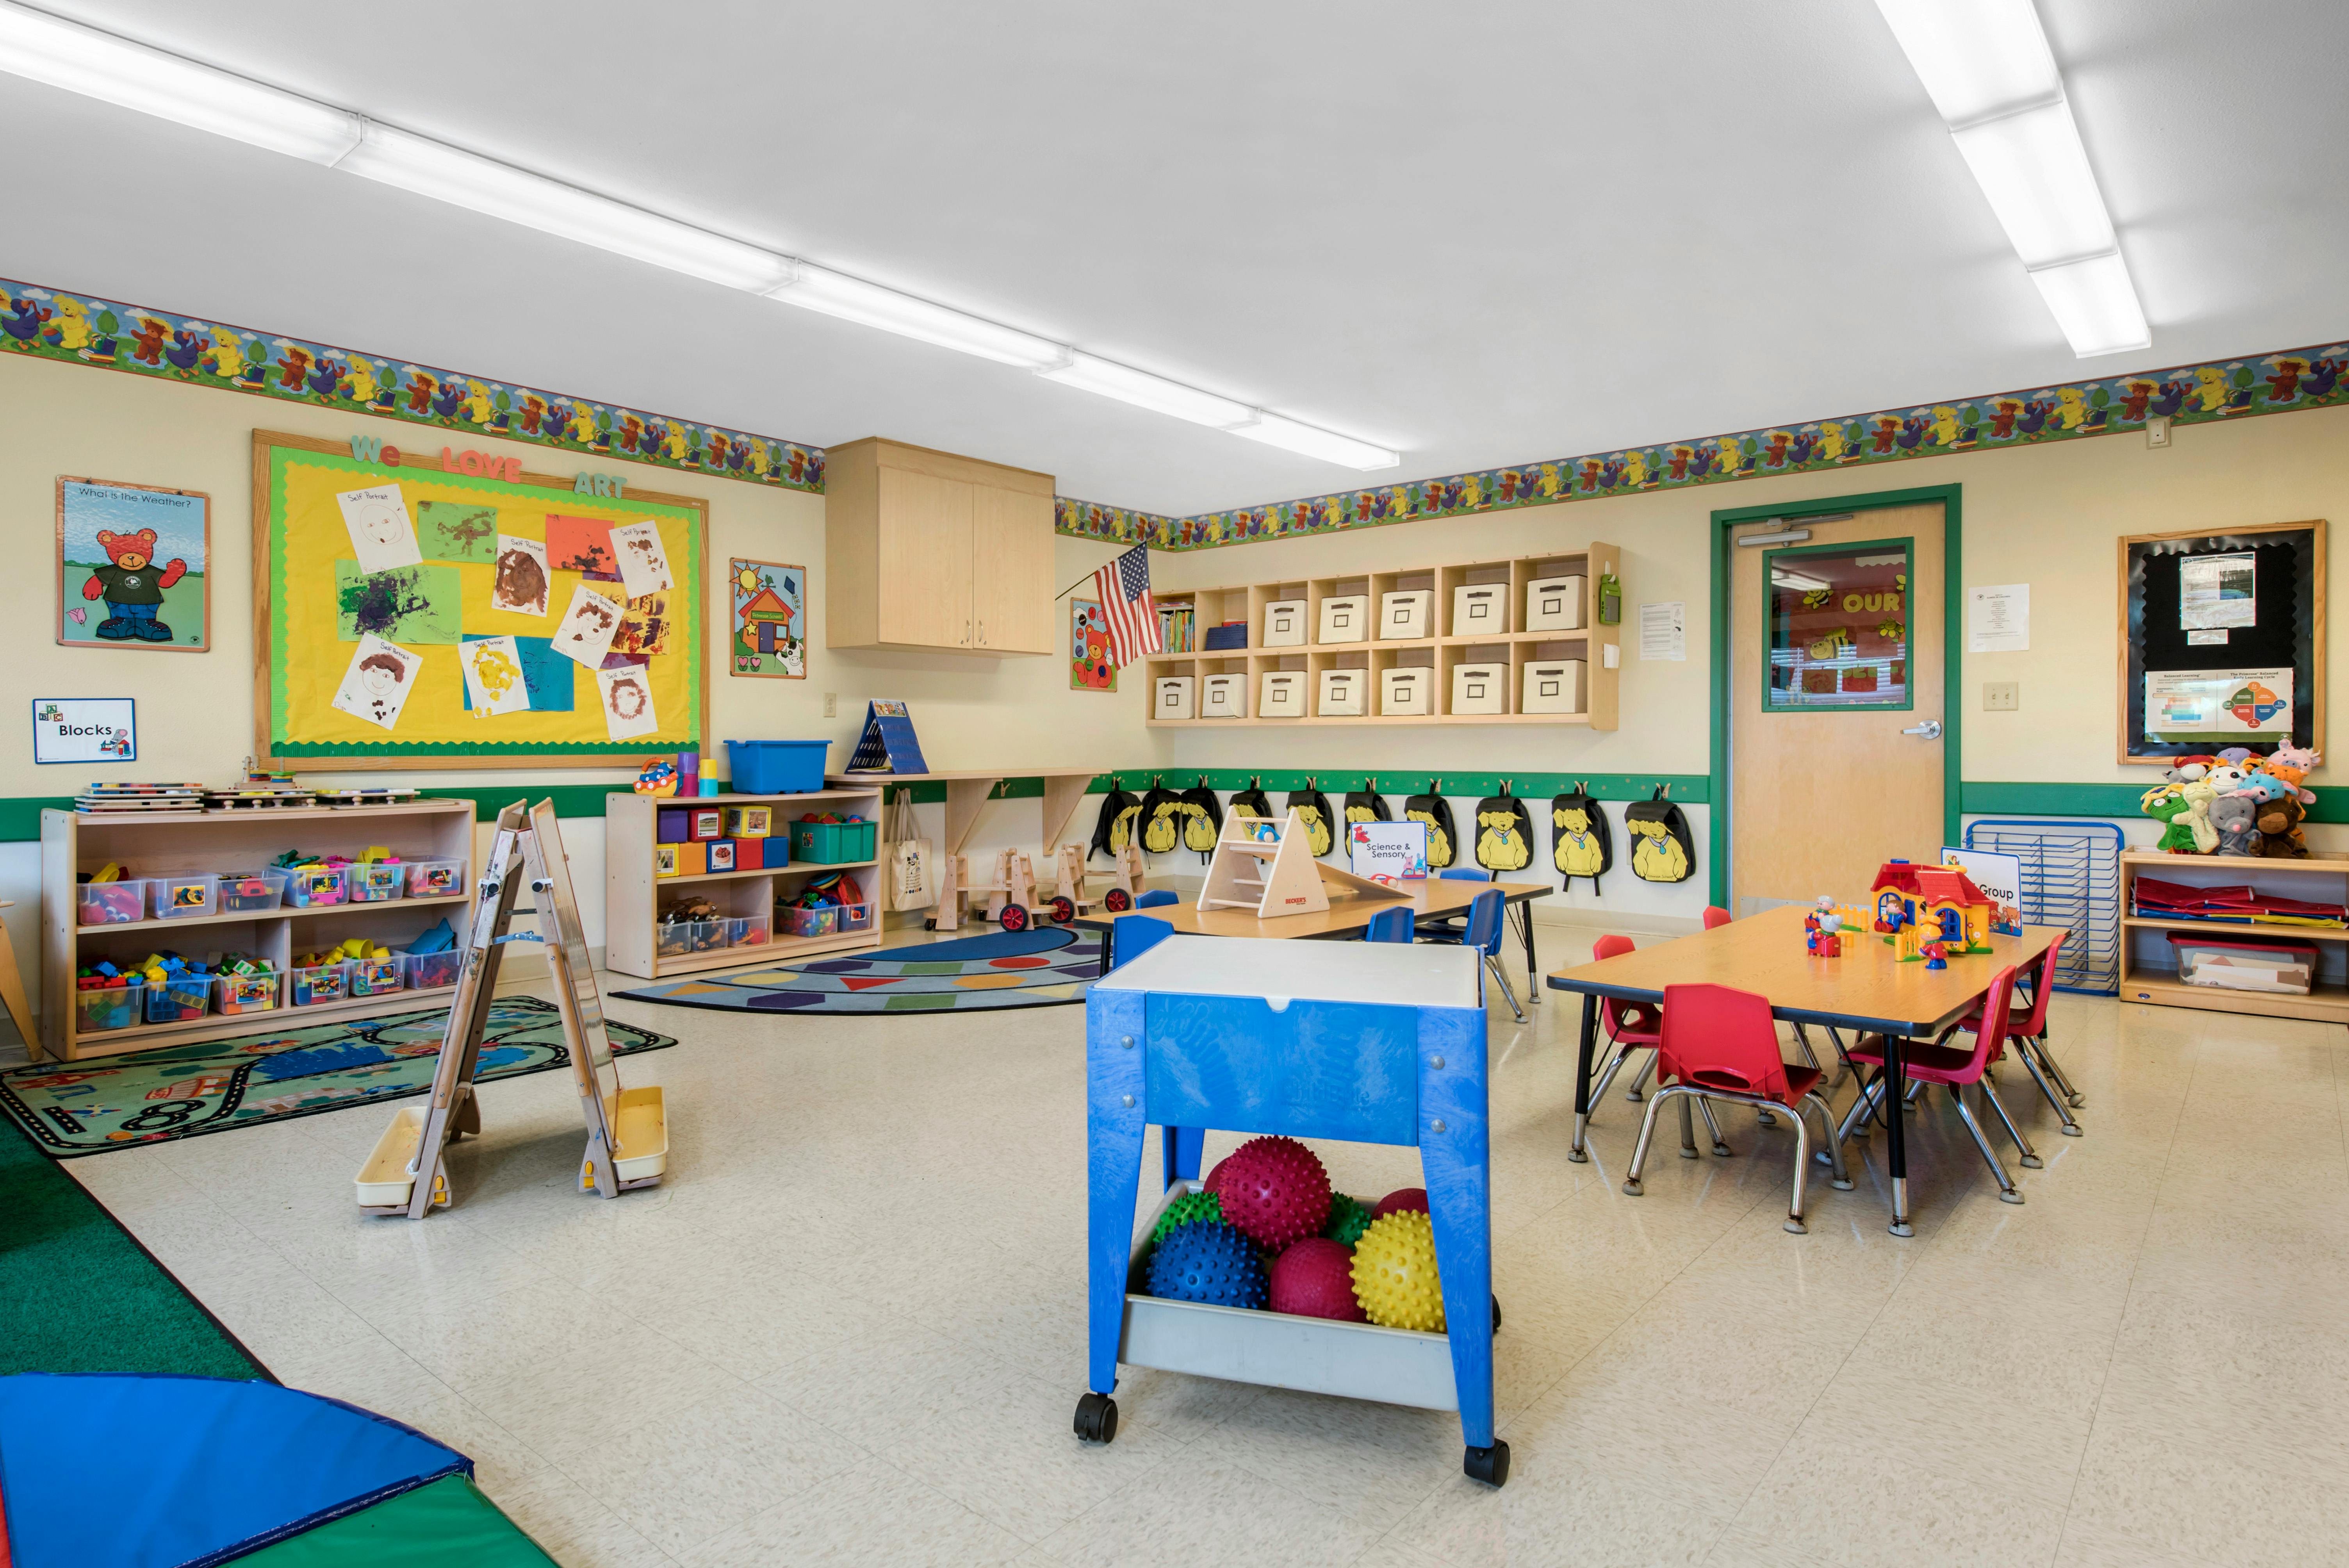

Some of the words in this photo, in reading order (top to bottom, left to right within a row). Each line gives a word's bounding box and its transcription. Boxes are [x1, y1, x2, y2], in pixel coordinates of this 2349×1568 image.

[351, 435, 400, 467] We
[442, 447, 522, 483] LOVE
[574, 471, 628, 499] ART
[79, 488, 107, 498] What
[121, 493, 138, 502] the
[141, 495, 191, 508] Weather?
[348, 493, 362, 502] Self
[364, 491, 388, 500] Portrait
[524, 540, 543, 552] Portrait
[586, 591, 597, 601] Self
[599, 596, 613, 611] Portrait
[1843, 593, 1900, 613] OUR
[380, 642, 392, 651] Self
[393, 648, 410, 661] Portrait
[59, 724, 112, 736] Blocks
[1979, 884, 2014, 901] Group
